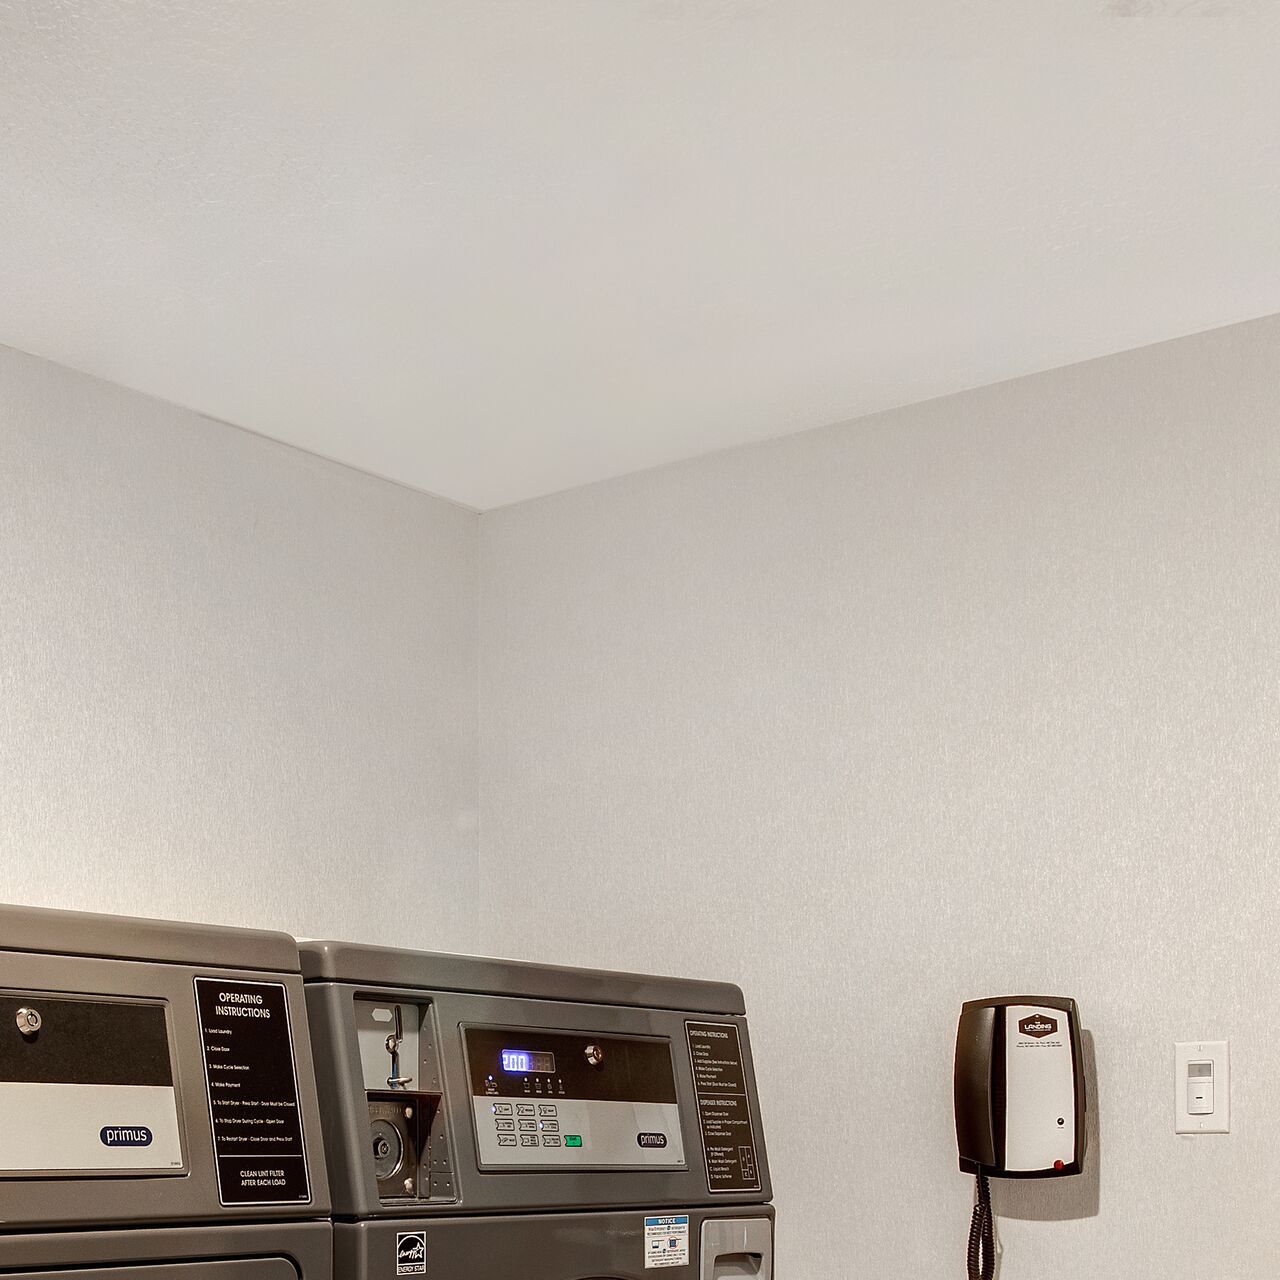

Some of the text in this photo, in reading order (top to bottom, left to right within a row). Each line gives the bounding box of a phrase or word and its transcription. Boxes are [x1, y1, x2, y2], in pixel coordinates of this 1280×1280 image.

[218, 992, 263, 1005] OPERATING
[215, 1005, 271, 1019] INSTRUCTIONS
[106, 1127, 147, 1144] primus
[640, 1133, 665, 1146] primus
[398, 1265, 413, 1273] ENERGY
